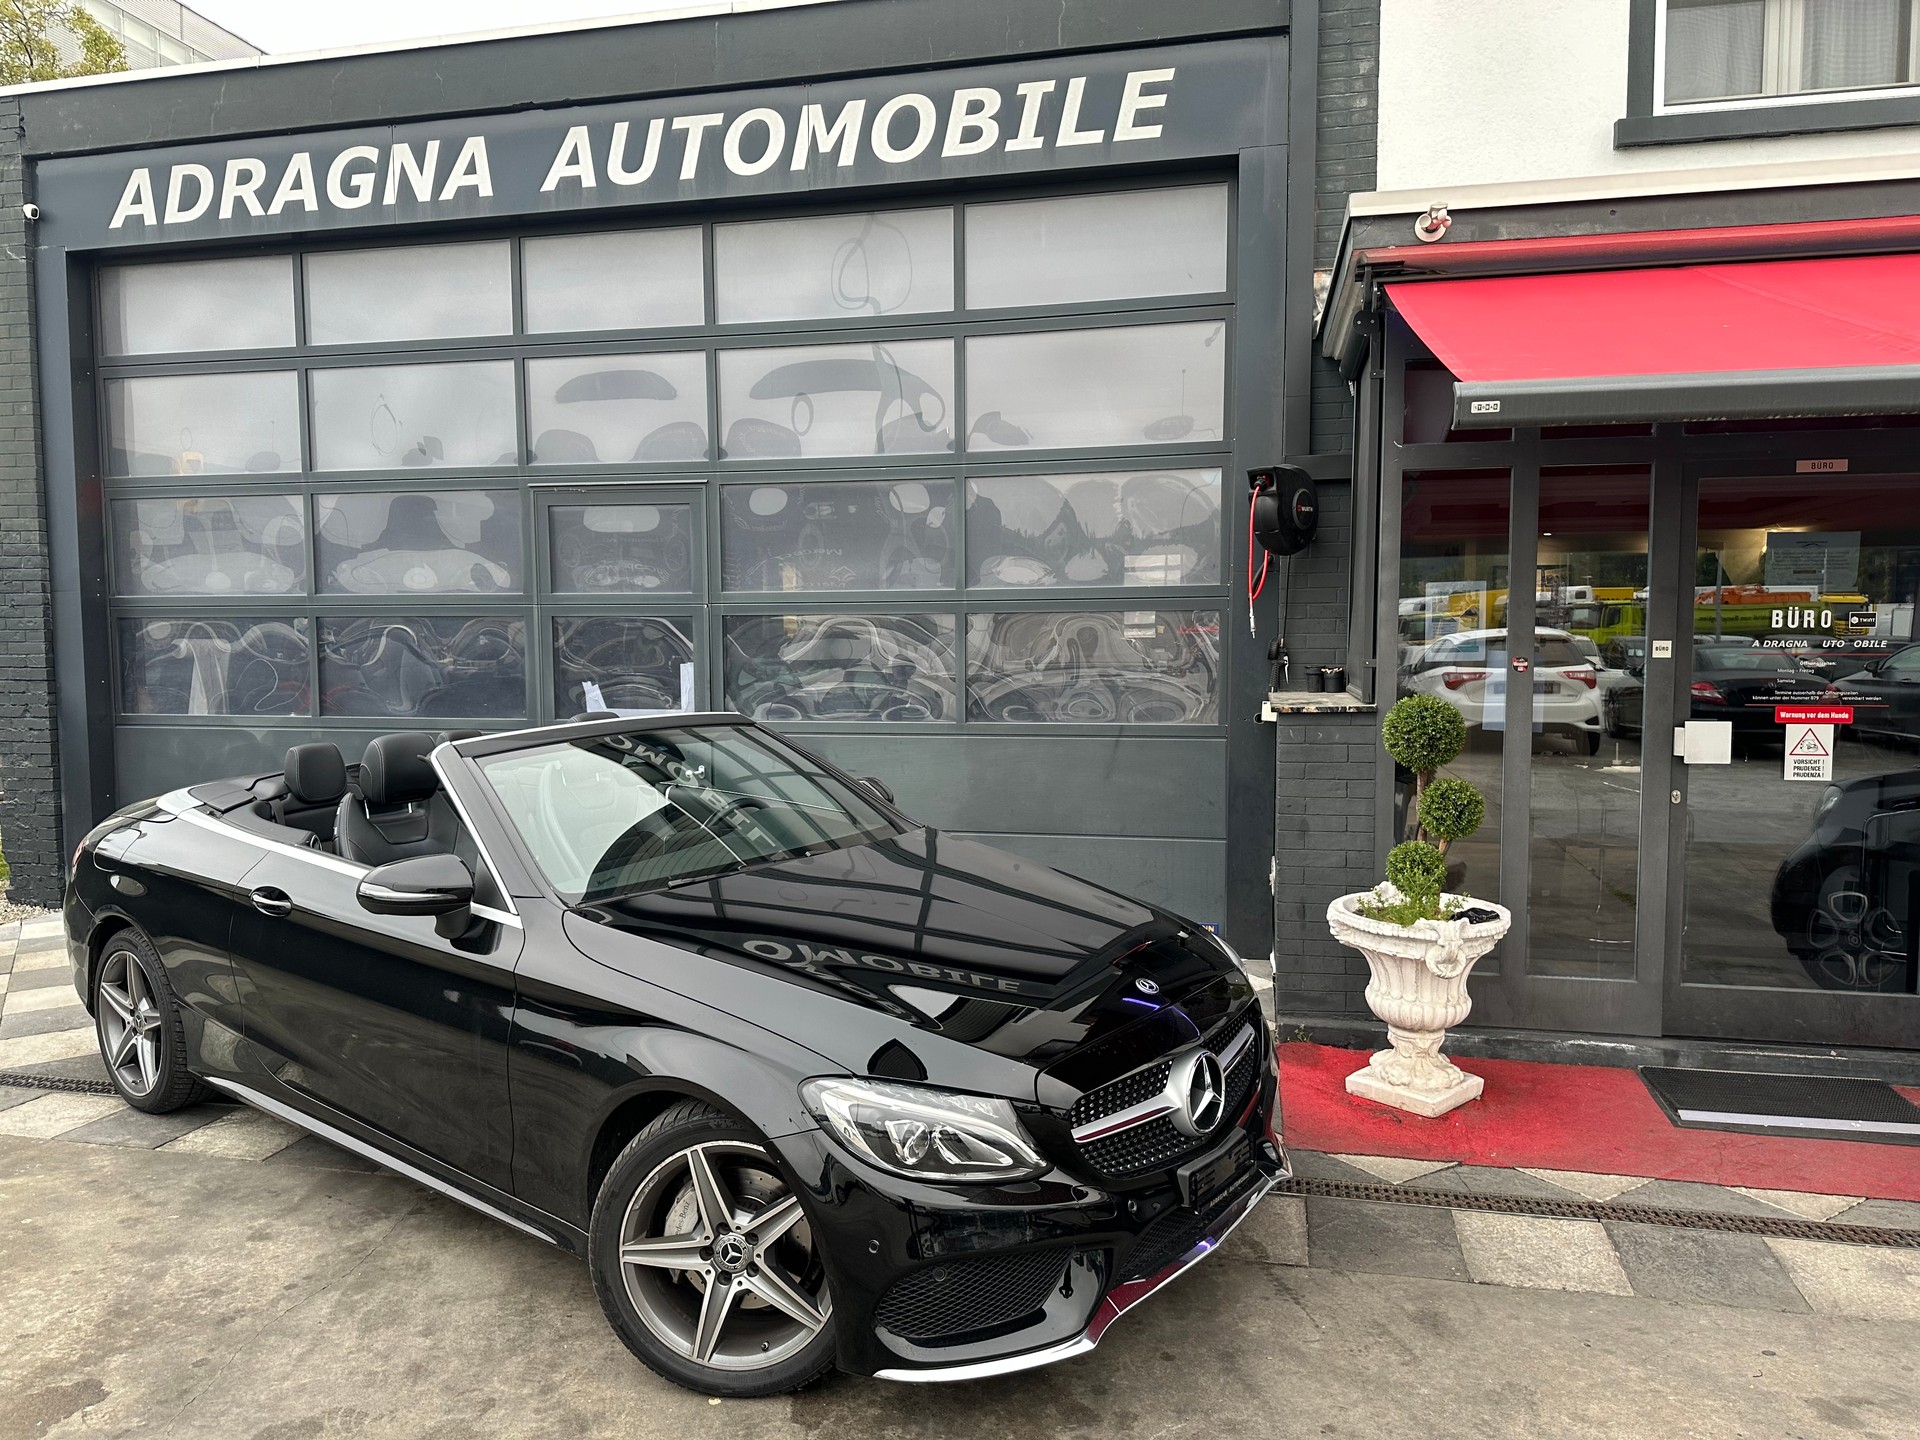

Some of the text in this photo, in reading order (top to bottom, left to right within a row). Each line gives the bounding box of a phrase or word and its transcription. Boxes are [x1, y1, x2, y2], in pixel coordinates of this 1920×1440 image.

[108, 67, 1176, 229] ADRAGNA AUTOMOBILE
[1811, 461, 1834, 470] BÜRO
[1771, 606, 1832, 629] BÜRO
[1780, 711, 1806, 719] Warnung
[675, 1201, 691, 1236] edes-Benz
